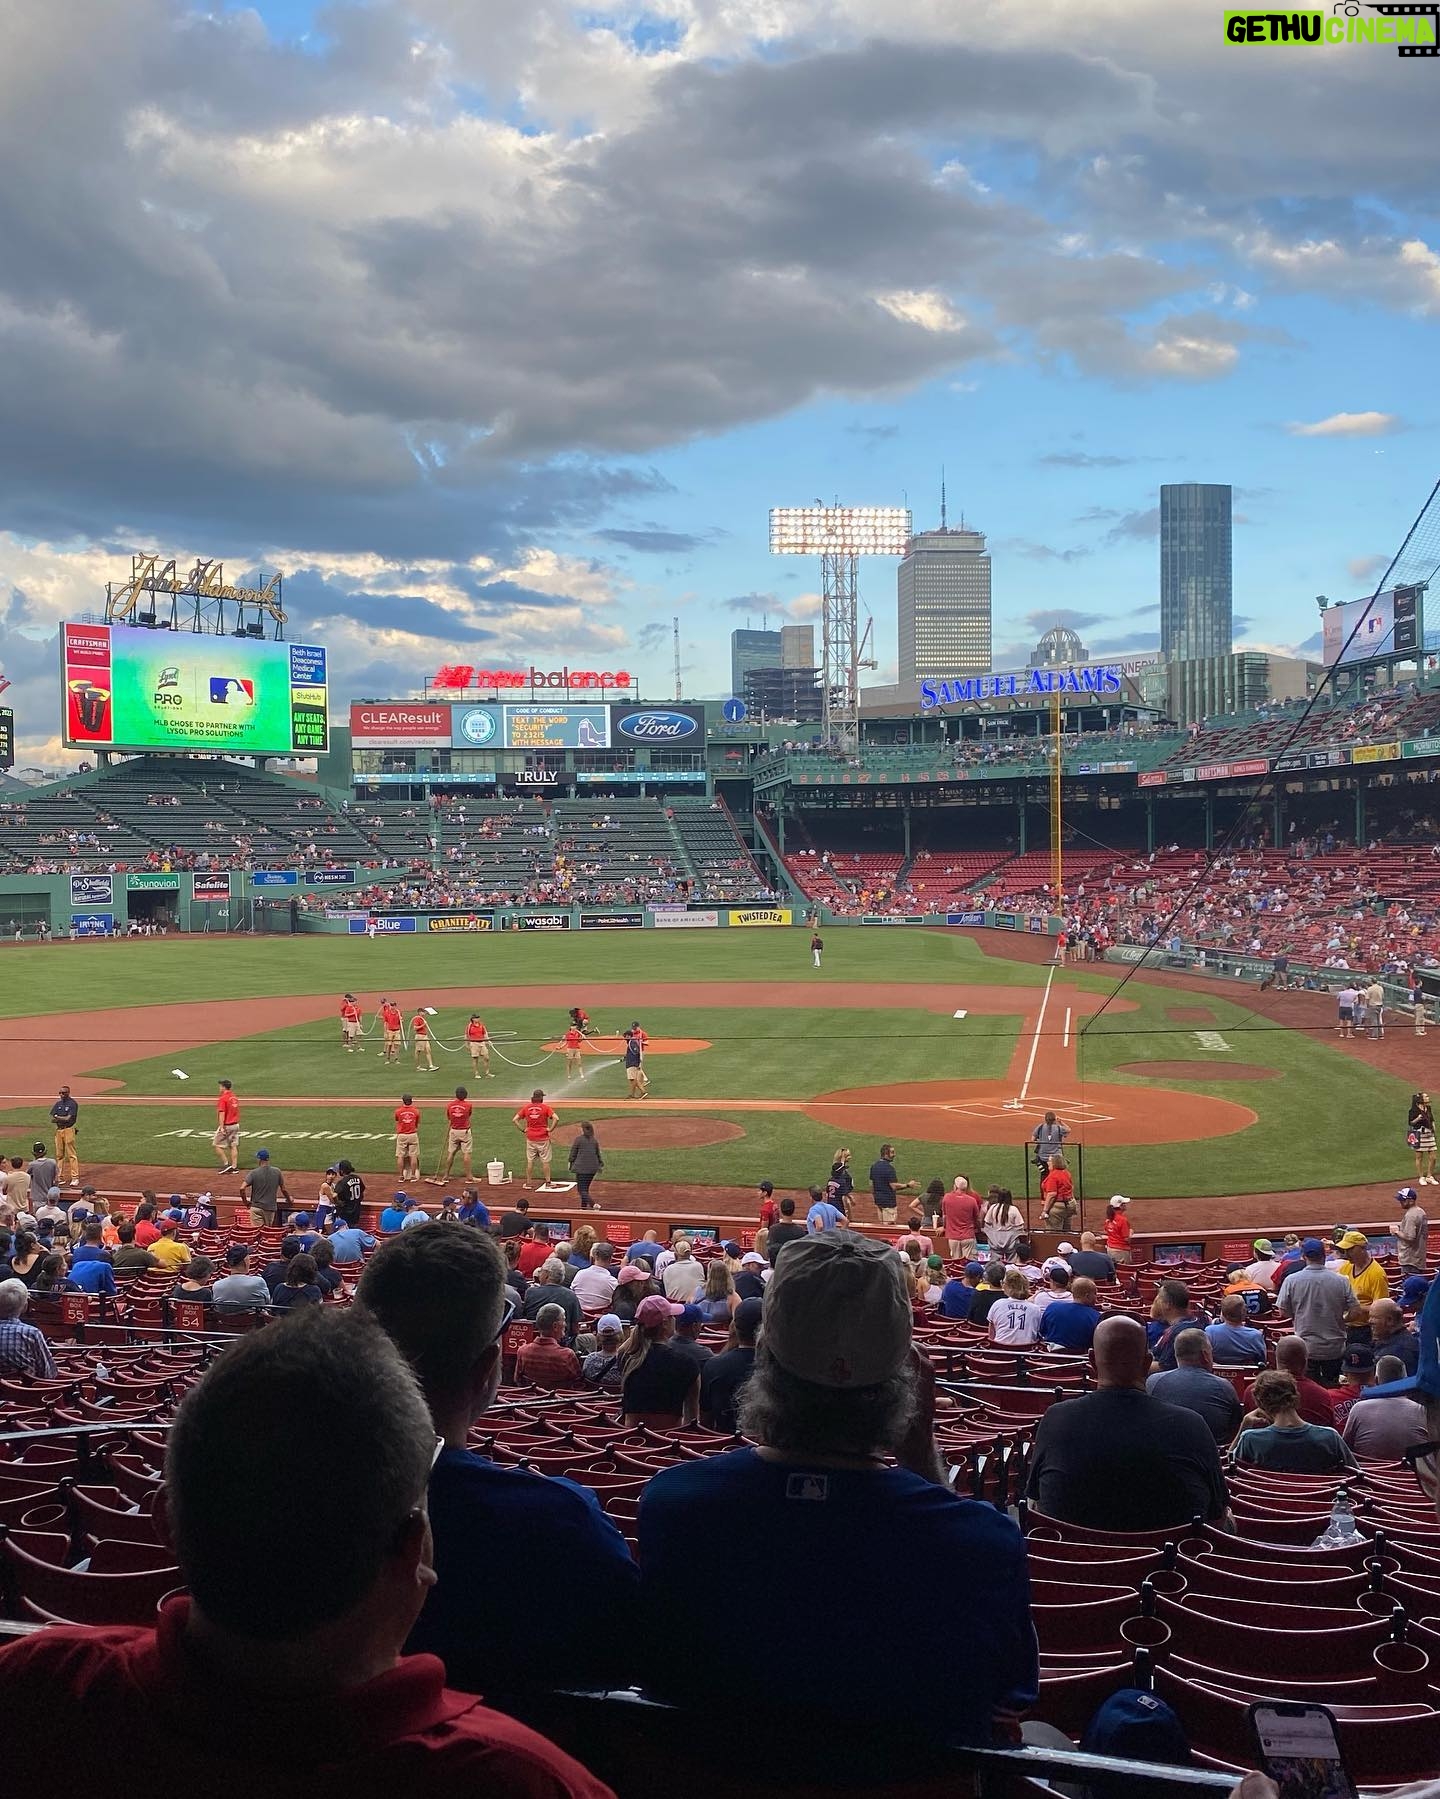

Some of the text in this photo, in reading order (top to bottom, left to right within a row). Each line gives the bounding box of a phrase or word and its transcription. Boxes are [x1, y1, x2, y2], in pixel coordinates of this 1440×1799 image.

[109, 552, 288, 623] John Hancock
[70, 638, 107, 648] CRAFTSMAN
[292, 648, 322, 658] Beth Israel
[292, 656, 323, 665] Deaconess
[293, 672, 312, 680] Center
[477, 666, 631, 688] new balance
[921, 676, 1022, 709] SAMUEL
[1026, 667, 1122, 694] ADAMS
[154, 694, 182, 705] PRO
[297, 692, 321, 700] StubHub
[294, 713, 306, 722] ANY
[360, 712, 441, 724] CLEAResult
[154, 719, 168, 727] MLB
[170, 720, 192, 728] CHOSE
[194, 721, 204, 729] TO
[206, 722, 238, 730] PARTNER
[295, 724, 306, 734] ANY
[634, 714, 682, 736] Ford
[205, 729, 244, 738] SOLUTIONS
[297, 735, 308, 744] ANY
[515, 771, 558, 783] TRULY
[139, 879, 177, 888] sunovion
[195, 881, 229, 889] Safelite
[526, 916, 562, 926] wasabi
[738, 912, 782, 924] TWISTED TEA
[80, 920, 104, 929] IRVING
[430, 918, 469, 929] GRANITE
[350, 1185, 360, 1200] 10
[188, 1214, 202, 1227] 9
[68, 1311, 84, 1320] 55
[182, 1318, 200, 1327] 54
[1008, 1312, 1026, 1330] 11
